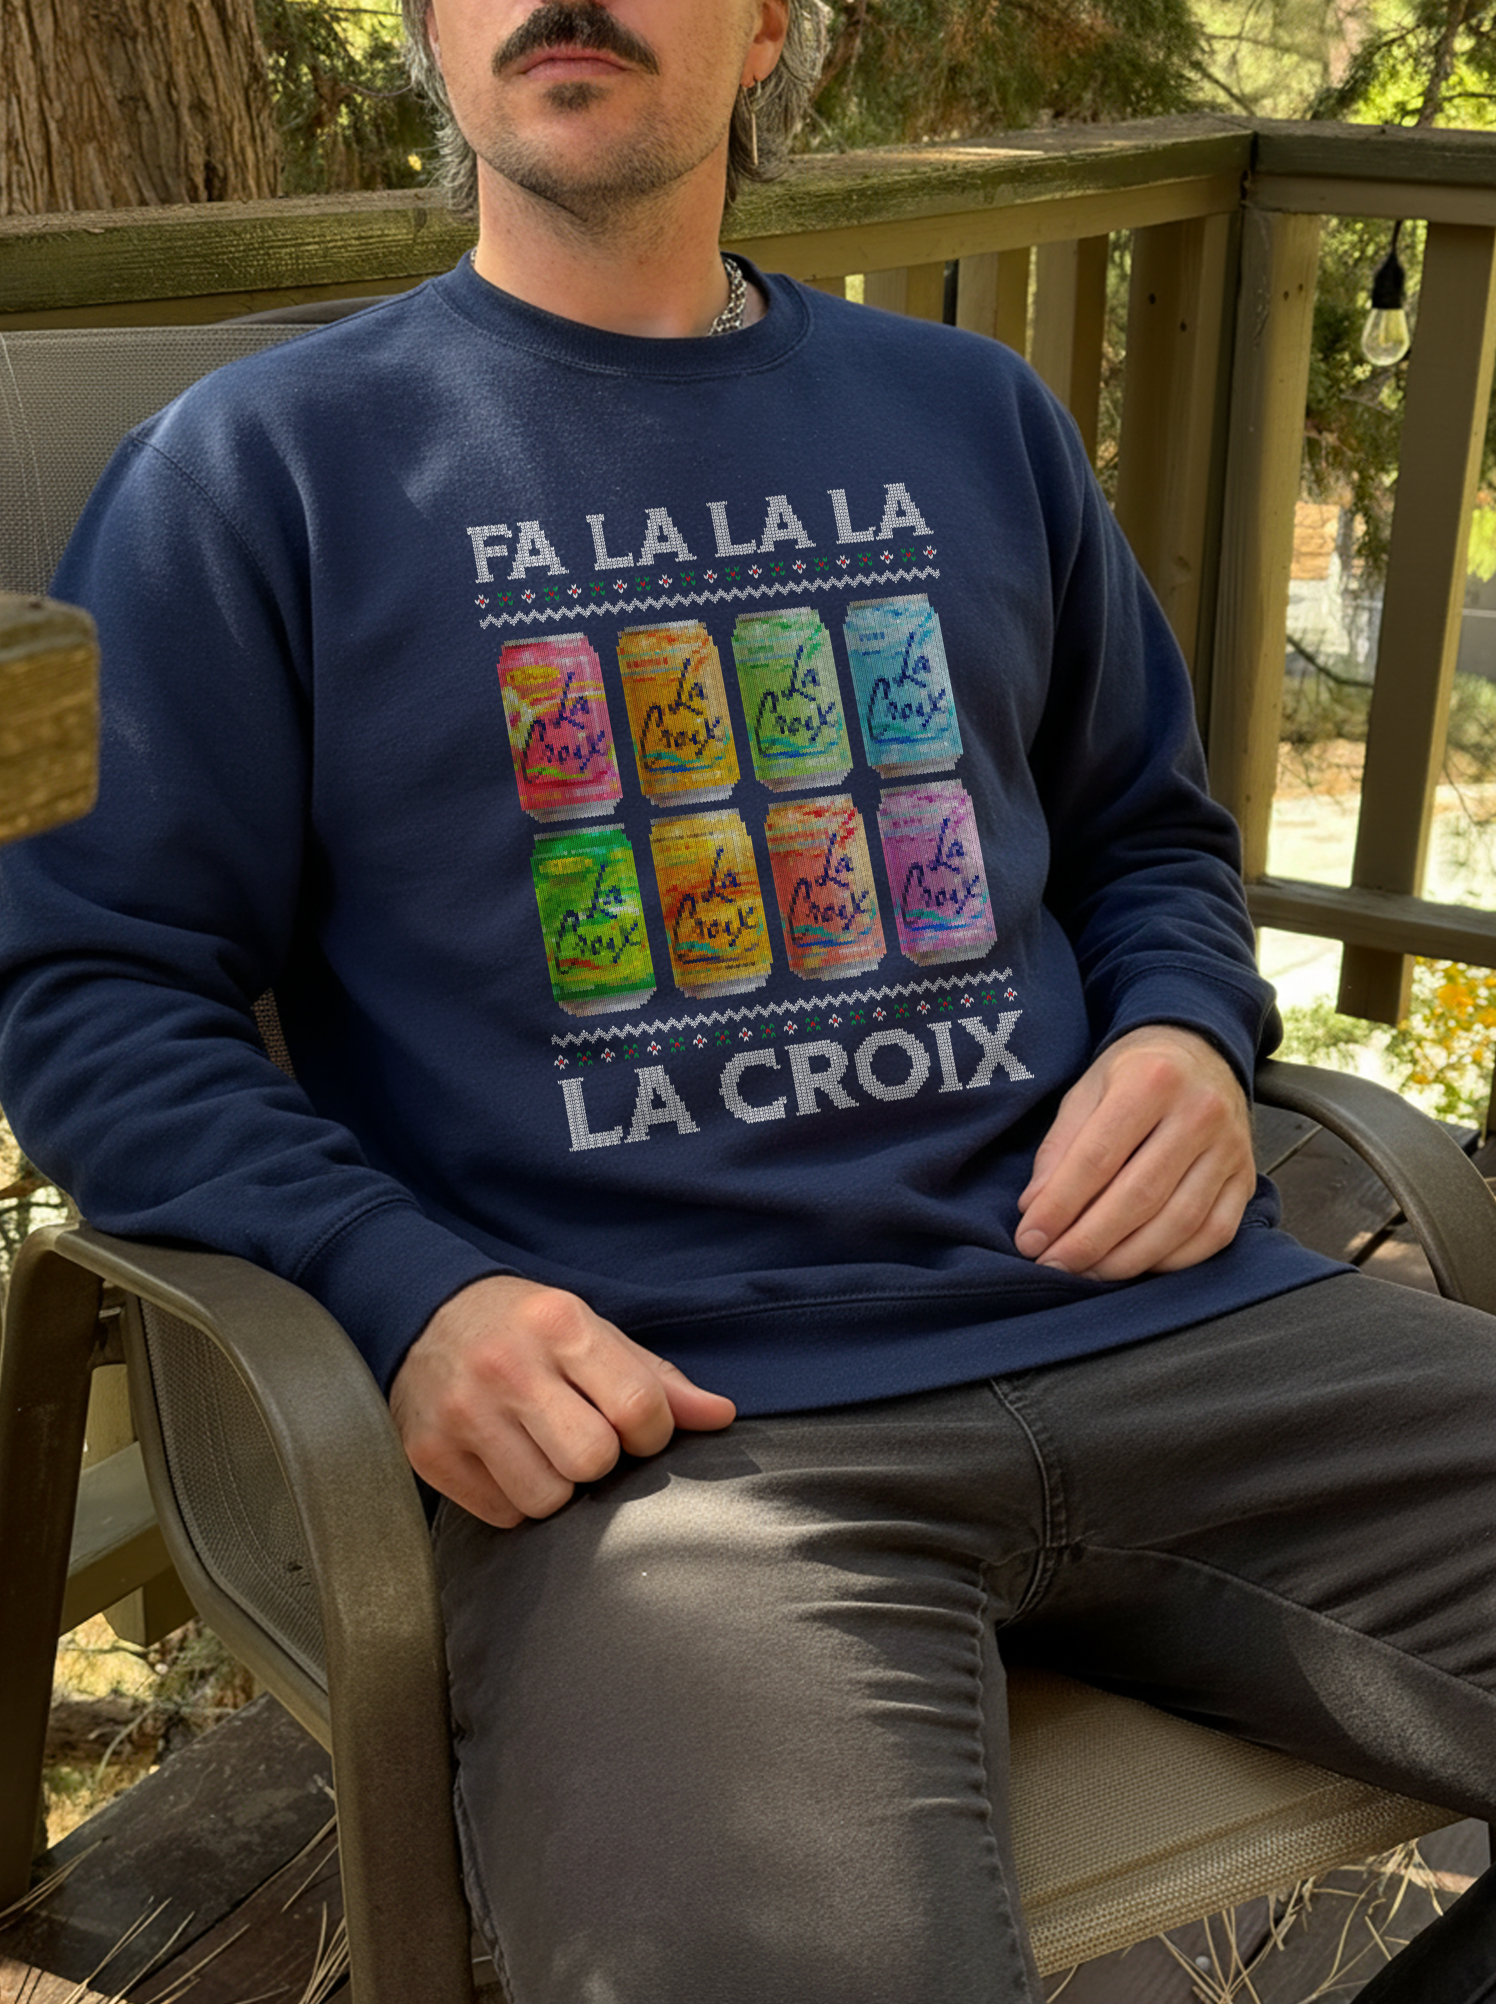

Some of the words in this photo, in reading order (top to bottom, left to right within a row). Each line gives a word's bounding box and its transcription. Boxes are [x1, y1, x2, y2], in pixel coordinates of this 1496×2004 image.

[466, 520, 569, 583] FA
[586, 507, 697, 570] LA
[706, 495, 816, 557] LA
[827, 483, 934, 544] LA
[557, 1065, 700, 1152] LA
[718, 1010, 1034, 1124] CROIX
